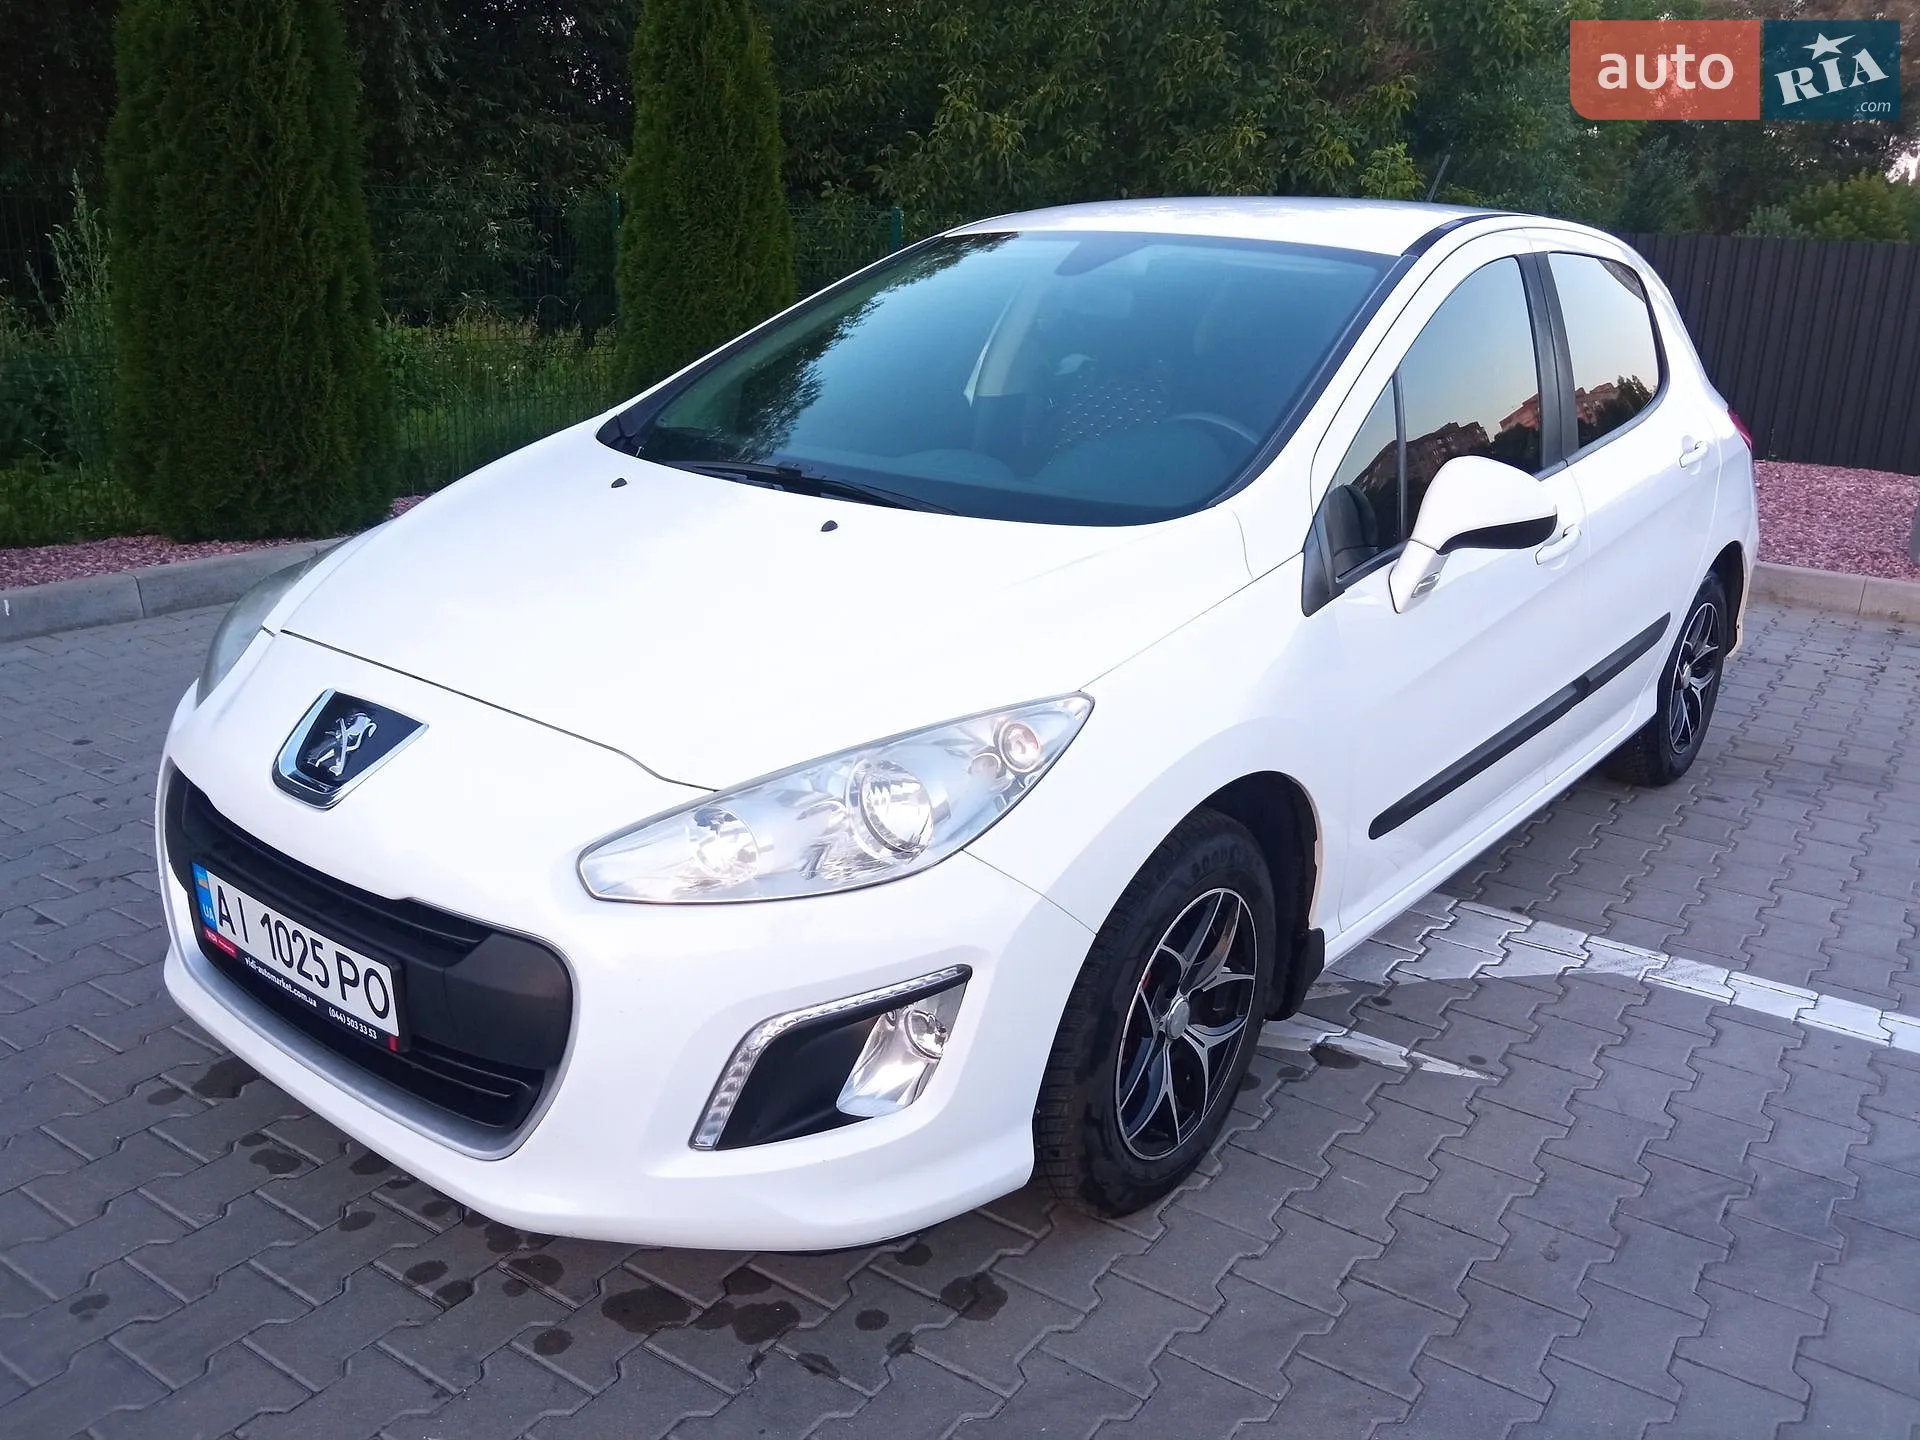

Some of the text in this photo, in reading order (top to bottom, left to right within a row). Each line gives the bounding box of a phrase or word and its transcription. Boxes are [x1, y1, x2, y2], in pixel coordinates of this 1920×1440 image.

[202, 903, 216, 921] UA
[217, 885, 390, 1020] AI 1025 PO
[328, 1007, 346, 1024] (044)
[346, 1018, 359, 1030] 503
[358, 1023, 368, 1035] 33
[368, 1028, 378, 1040] 53
